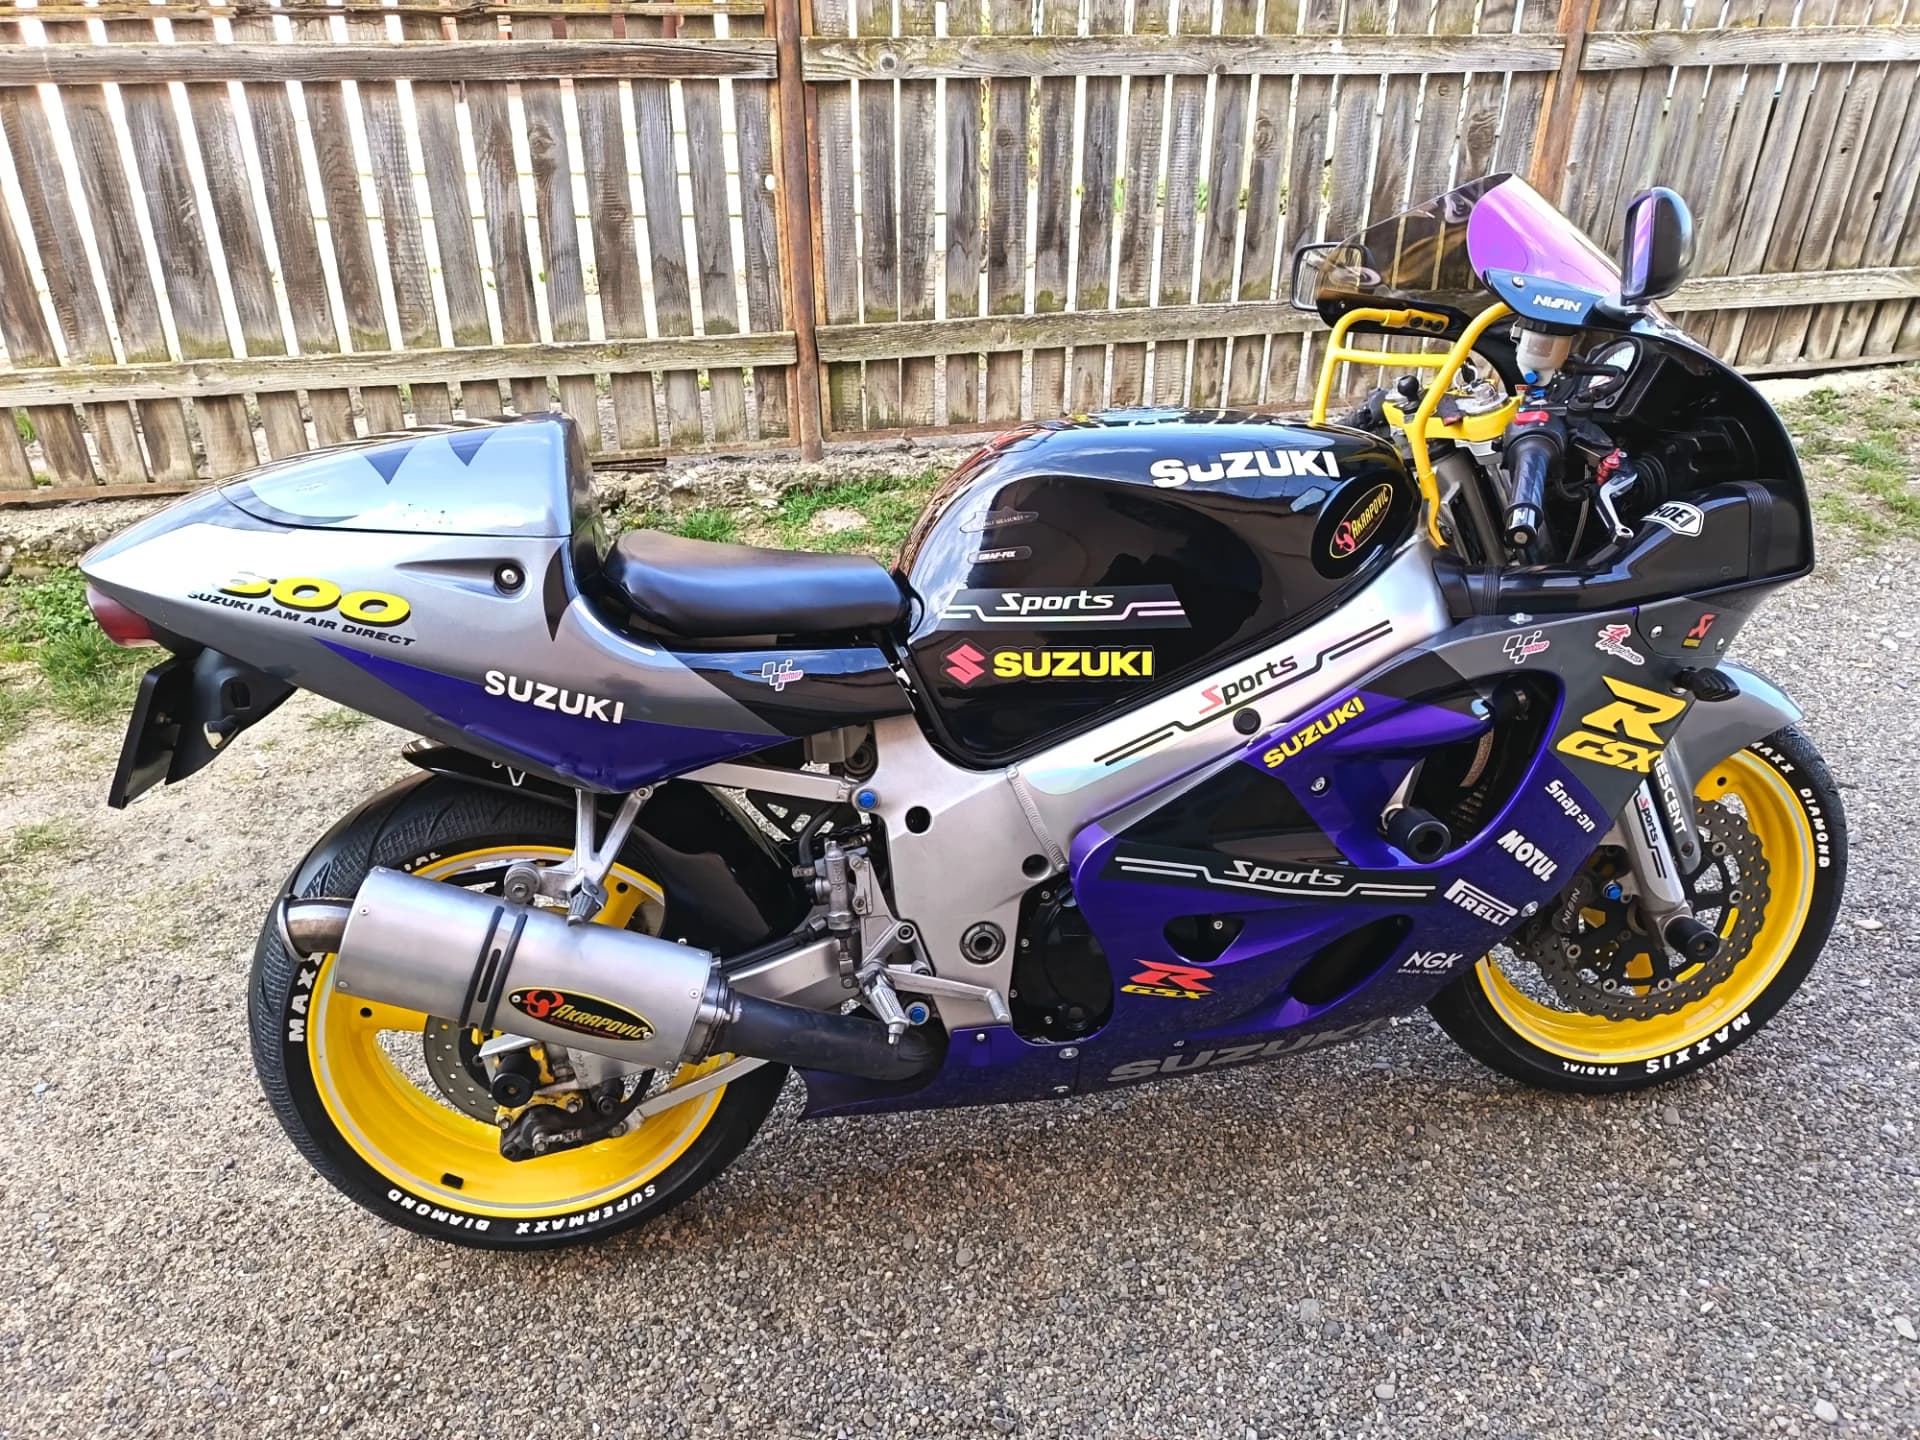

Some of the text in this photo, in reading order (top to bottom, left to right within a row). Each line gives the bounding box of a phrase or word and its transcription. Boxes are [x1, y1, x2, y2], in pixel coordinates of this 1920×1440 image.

[1150, 450, 1341, 488] SUZUKI
[187, 590, 416, 647] SUZUKI RAM AIR DIRECT
[995, 590, 1115, 615] Sports
[993, 651, 1153, 678] SUZUKI
[1198, 655, 1298, 715] Sports
[484, 670, 625, 724] SUZUKI
[1581, 674, 1688, 745] R
[1262, 696, 1366, 769] SUZUKI
[1556, 730, 1664, 773] GSX
[1640, 798, 1659, 842] Sports
[1800, 788, 1831, 868] DIAMOND
[1224, 860, 1345, 886] Sports
[1497, 829, 1559, 882] MOTUL
[1443, 878, 1519, 926] PIRELLI
[1130, 959, 1216, 992] R
[1403, 951, 1464, 969] NGK
[1120, 984, 1215, 1000] GSX
[1562, 1011, 1751, 1076] MAXXIS RADIAL
[387, 1183, 656, 1235] SUPERMAXX DIAMOND
